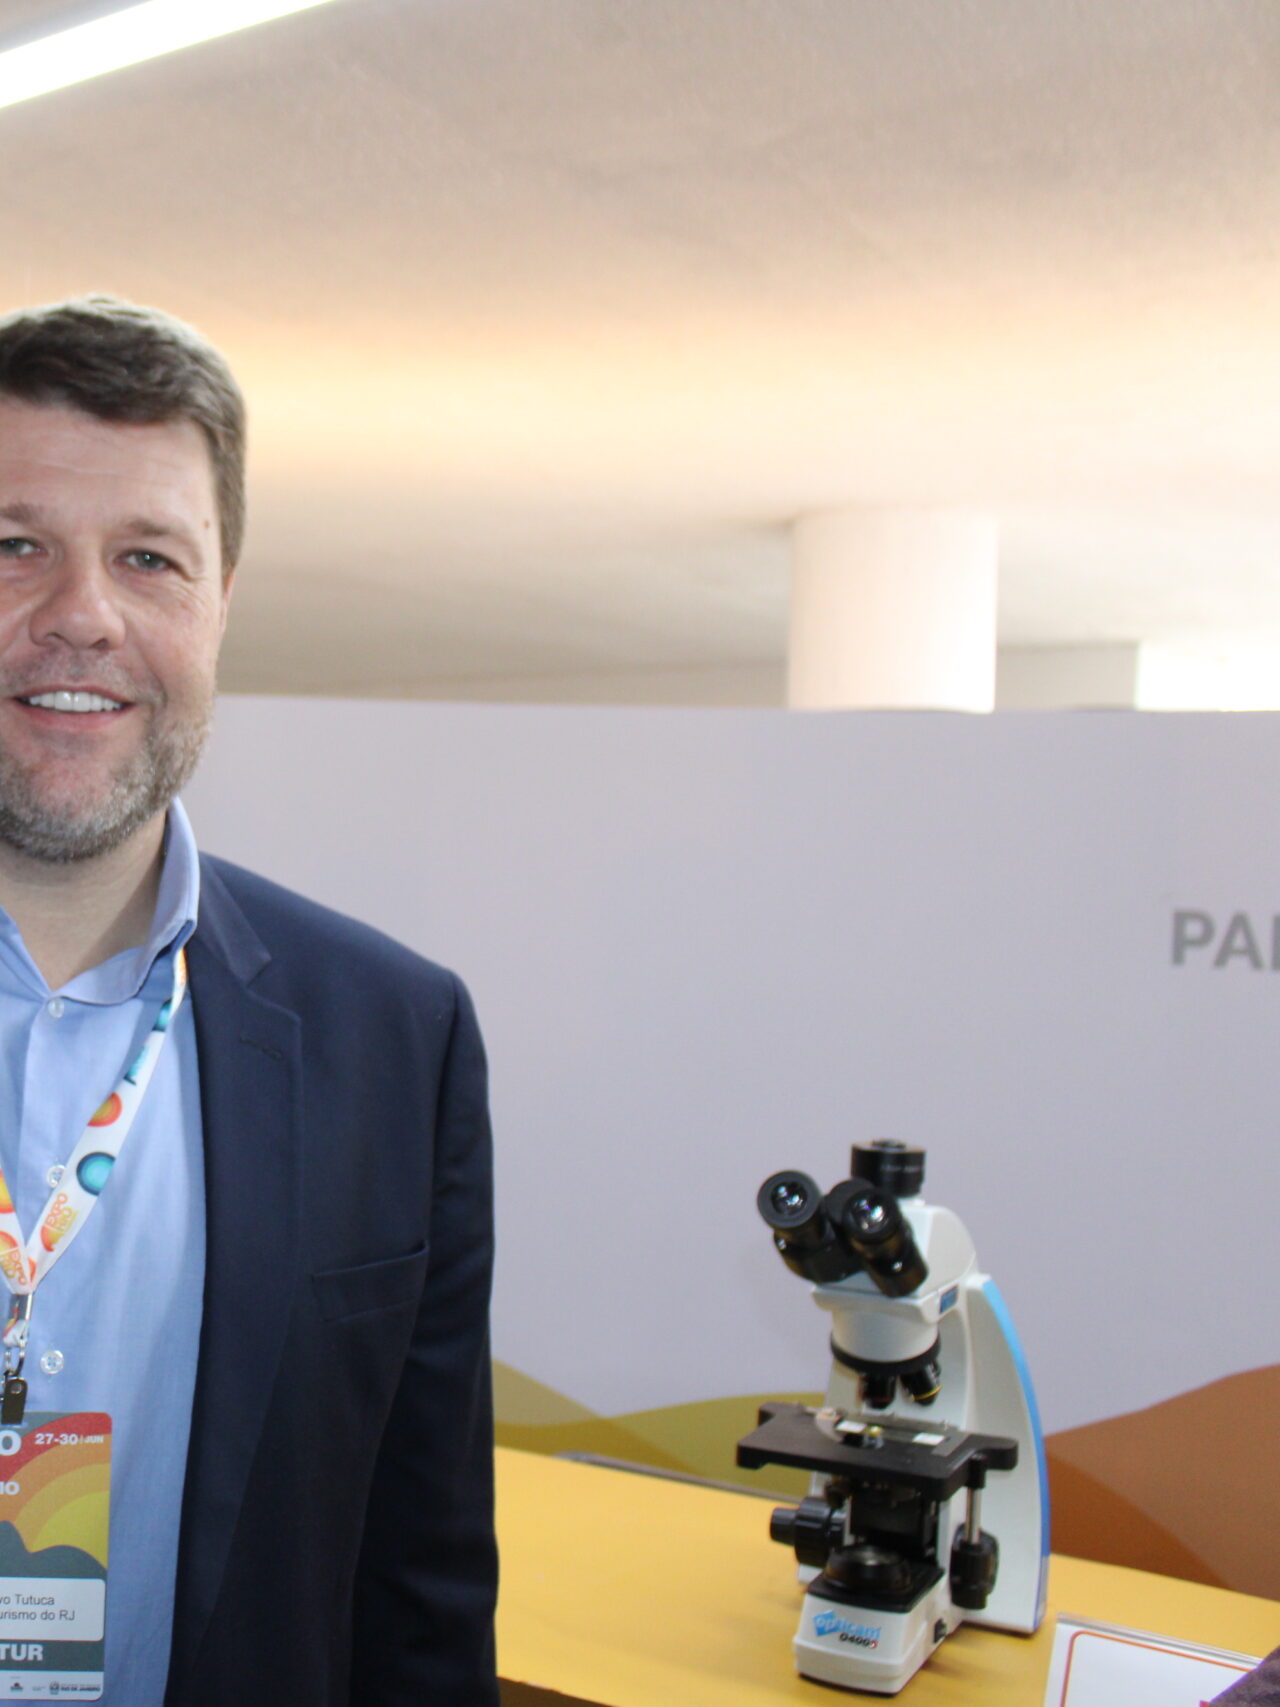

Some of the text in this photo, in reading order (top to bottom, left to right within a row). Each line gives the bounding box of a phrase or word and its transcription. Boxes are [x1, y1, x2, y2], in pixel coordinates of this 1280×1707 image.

[15, 1593, 55, 1605] Tutuca
[40, 1609, 56, 1620] do
[59, 1609, 75, 1621] RJ
